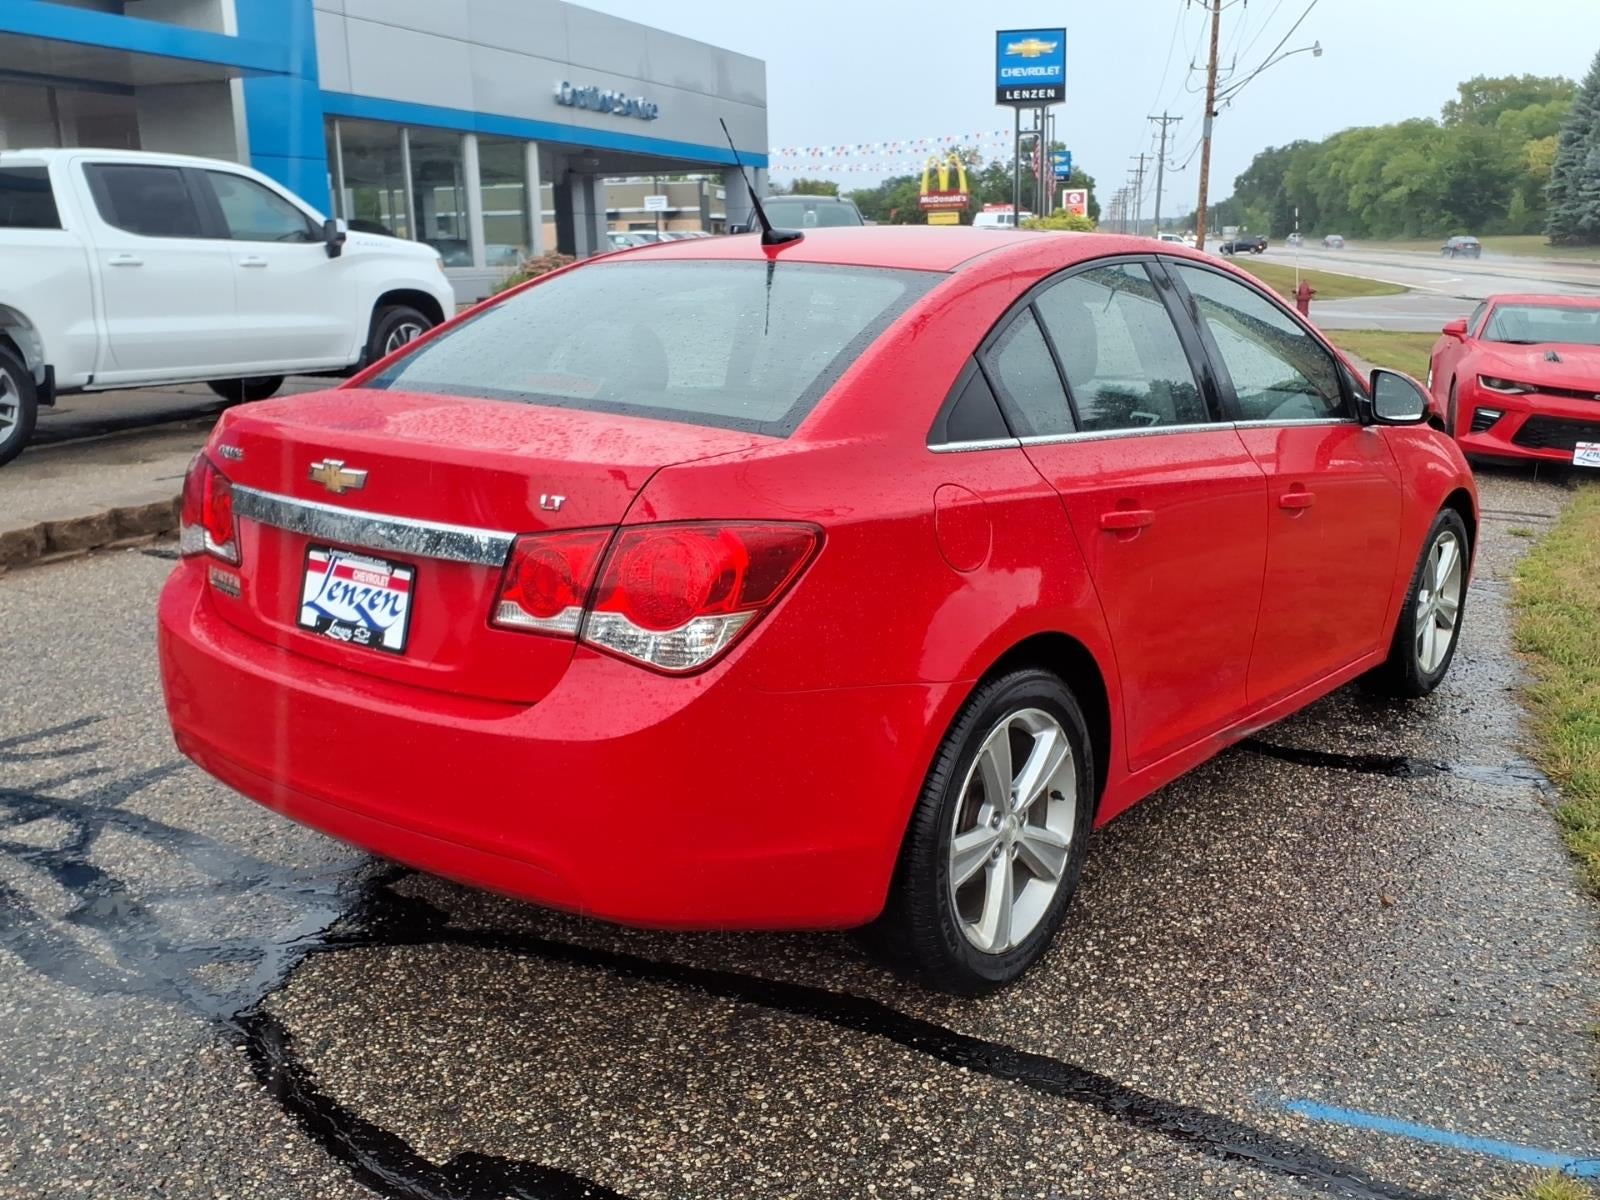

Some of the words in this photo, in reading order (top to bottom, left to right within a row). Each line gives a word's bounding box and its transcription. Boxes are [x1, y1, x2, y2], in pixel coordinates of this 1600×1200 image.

[1001, 66, 1060, 78] CHEVROLET
[1006, 89, 1056, 99] LENZEN
[920, 195, 967, 204] McDonald's
[540, 493, 566, 511] LT
[352, 569, 390, 588] CHEVROLET
[303, 555, 404, 633] Lenzen
